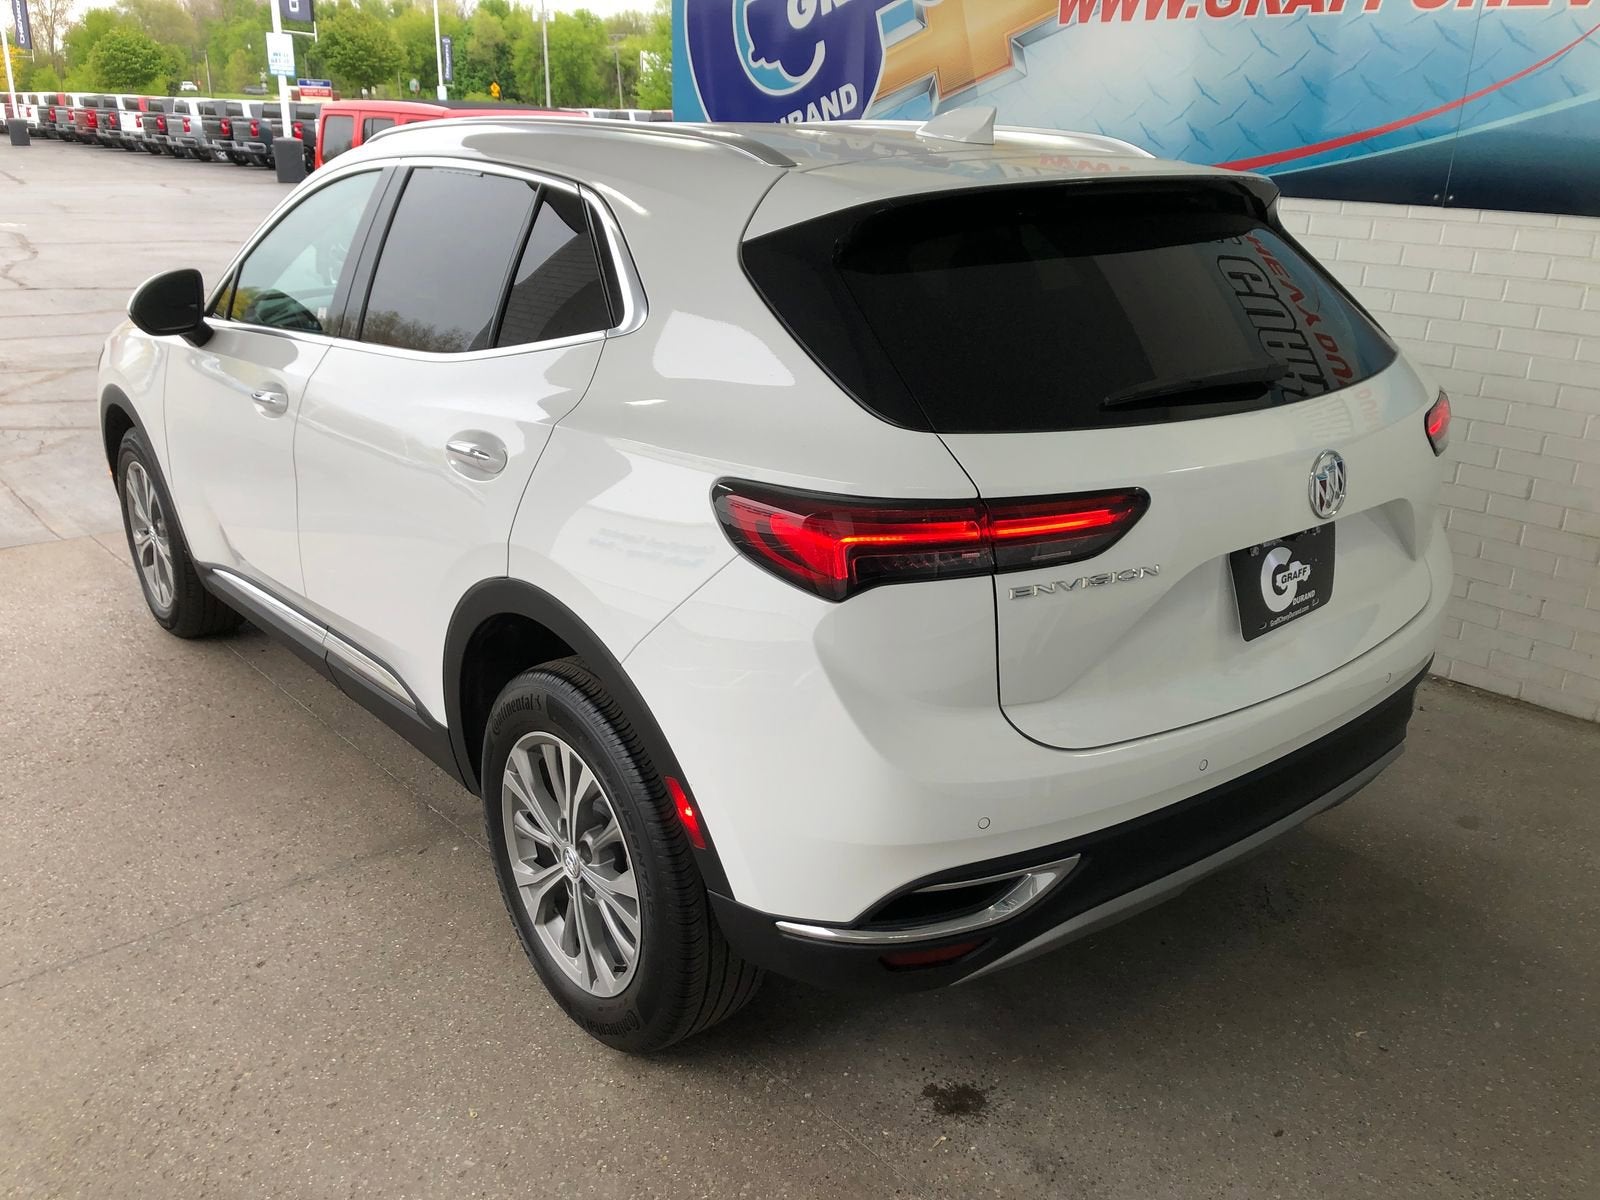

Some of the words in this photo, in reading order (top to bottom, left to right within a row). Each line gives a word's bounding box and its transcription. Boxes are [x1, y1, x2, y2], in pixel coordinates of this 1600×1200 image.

[1009, 564, 1160, 600] ENVISION
[1281, 566, 1308, 584] GRAFF
[1292, 590, 1316, 606] DURAND
